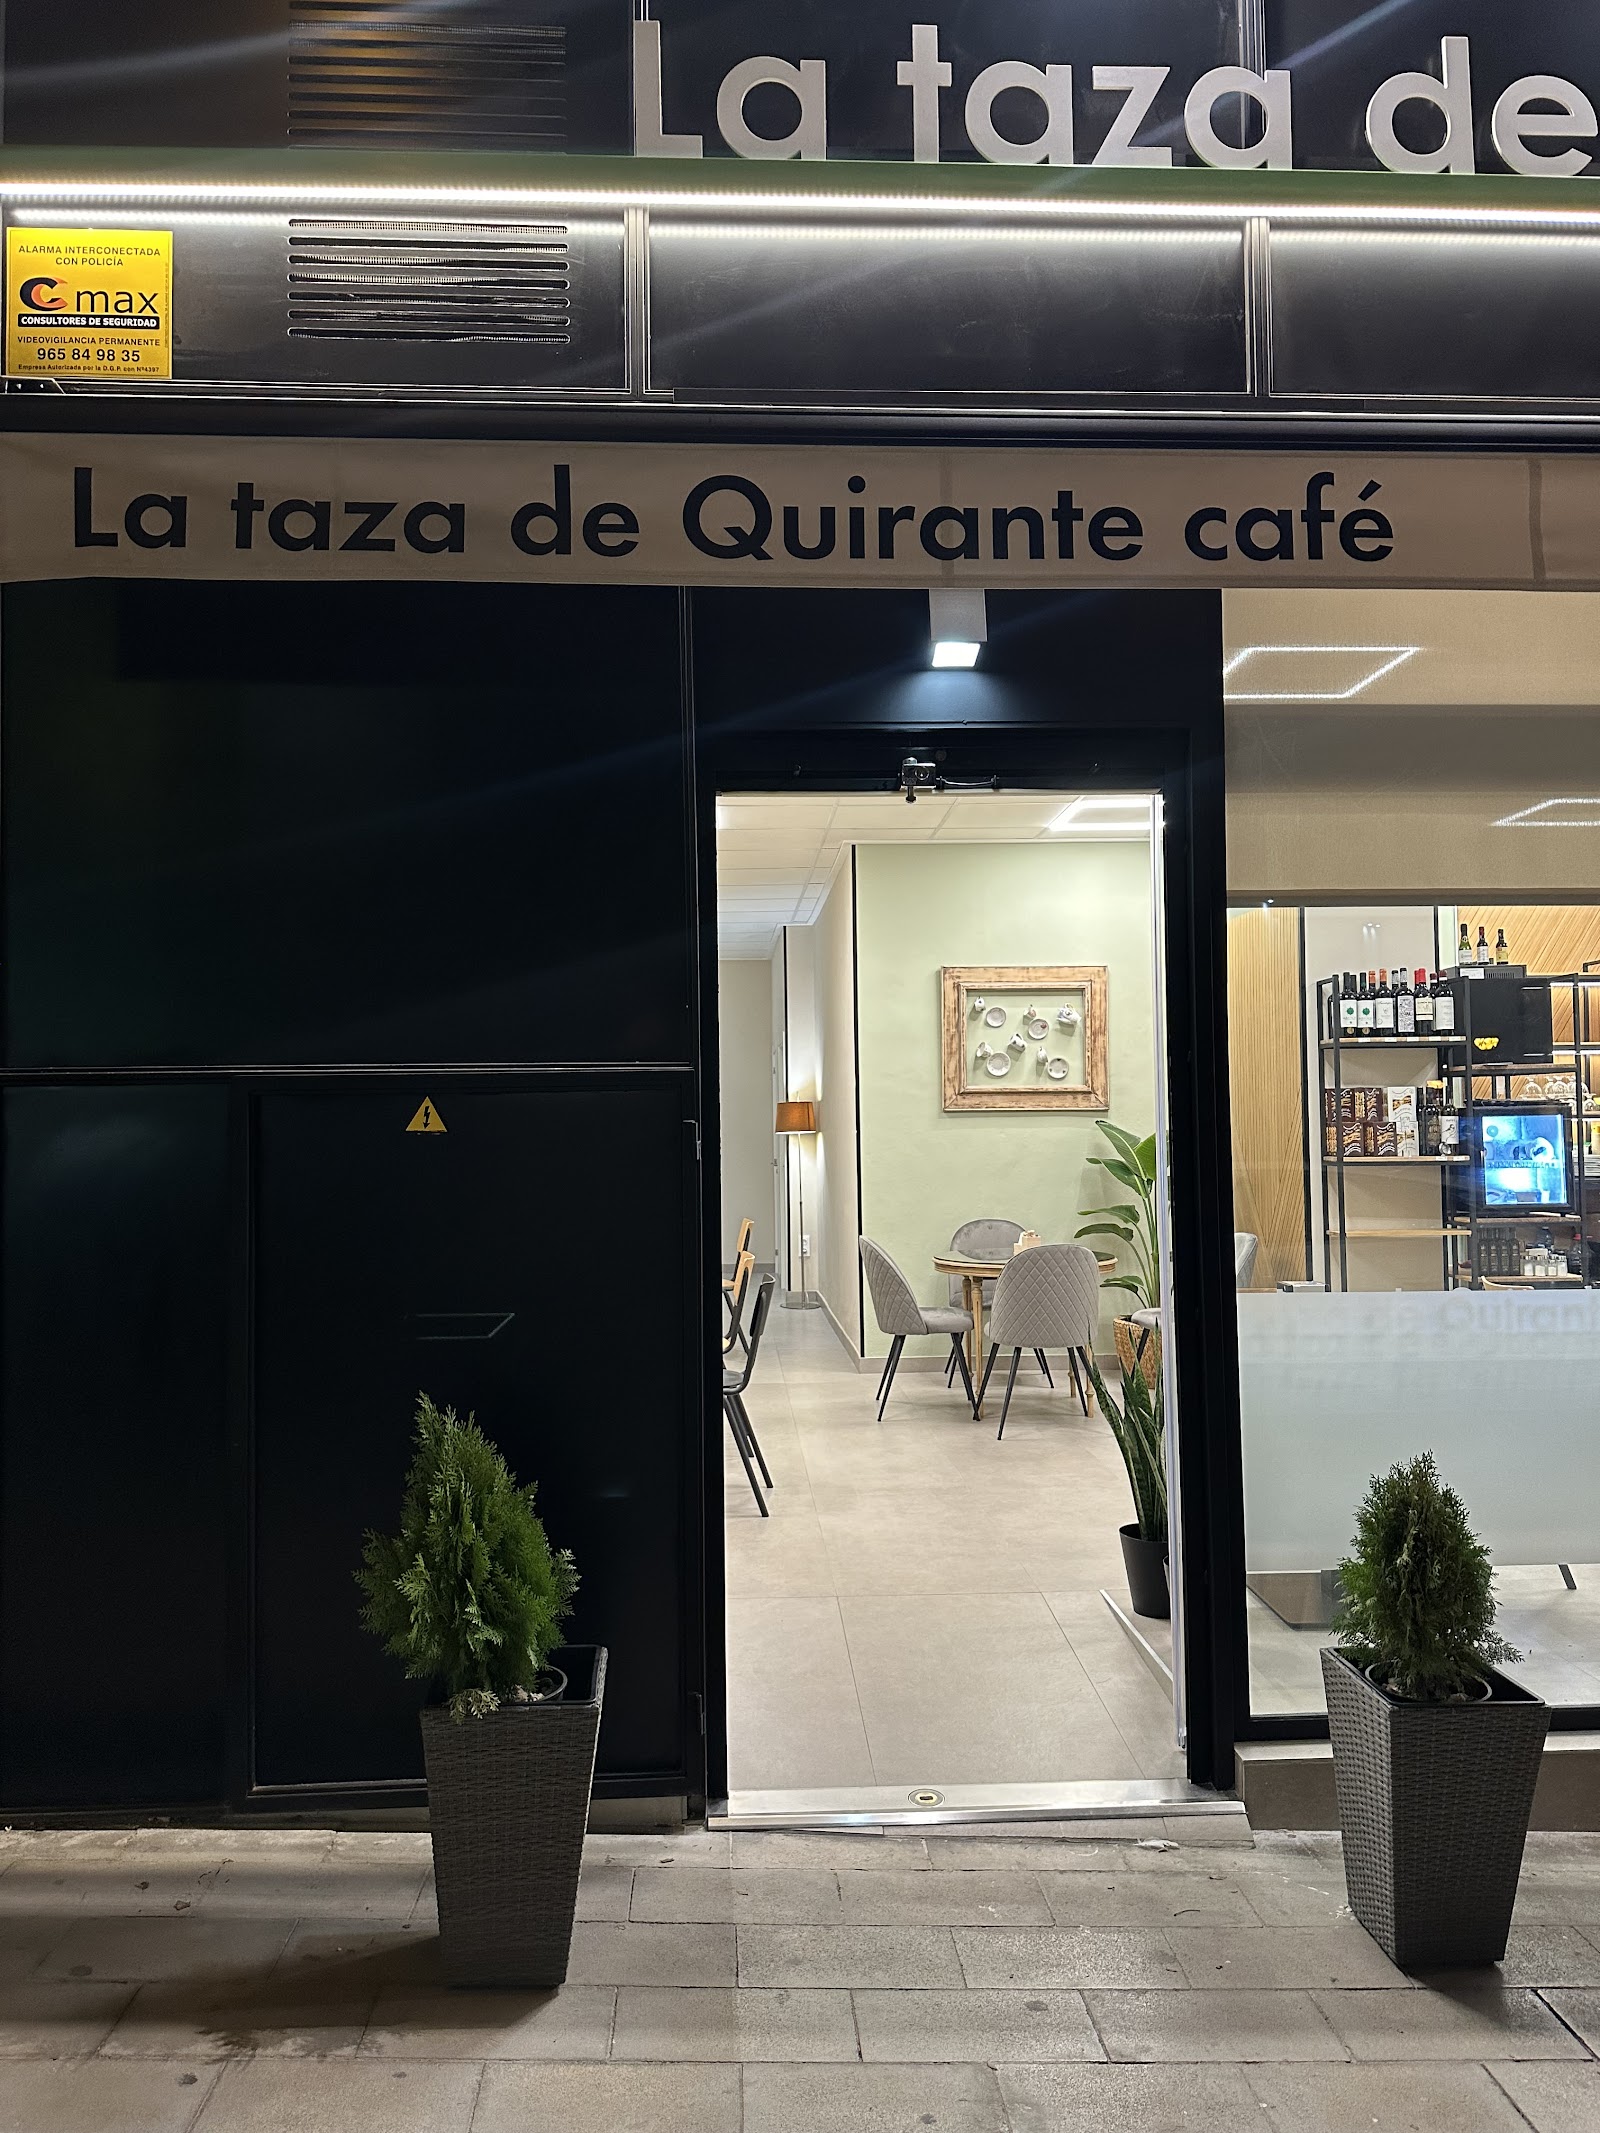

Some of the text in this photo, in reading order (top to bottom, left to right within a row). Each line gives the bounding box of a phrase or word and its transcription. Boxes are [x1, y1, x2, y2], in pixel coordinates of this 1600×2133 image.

[634, 20, 1598, 177] La taza de
[18, 245, 161, 256] ALARMA INTERCONECTADA
[55, 256, 124, 266] CON POLICÍA
[21, 316, 157, 327] CONSULTORES DE SEGURIDAD
[17, 336, 160, 346] VIDEOVIGILANCIA PERMANENTE
[37, 348, 140, 362] 965 84 98 35
[74, 464, 1394, 562] La taza de Quirante café
